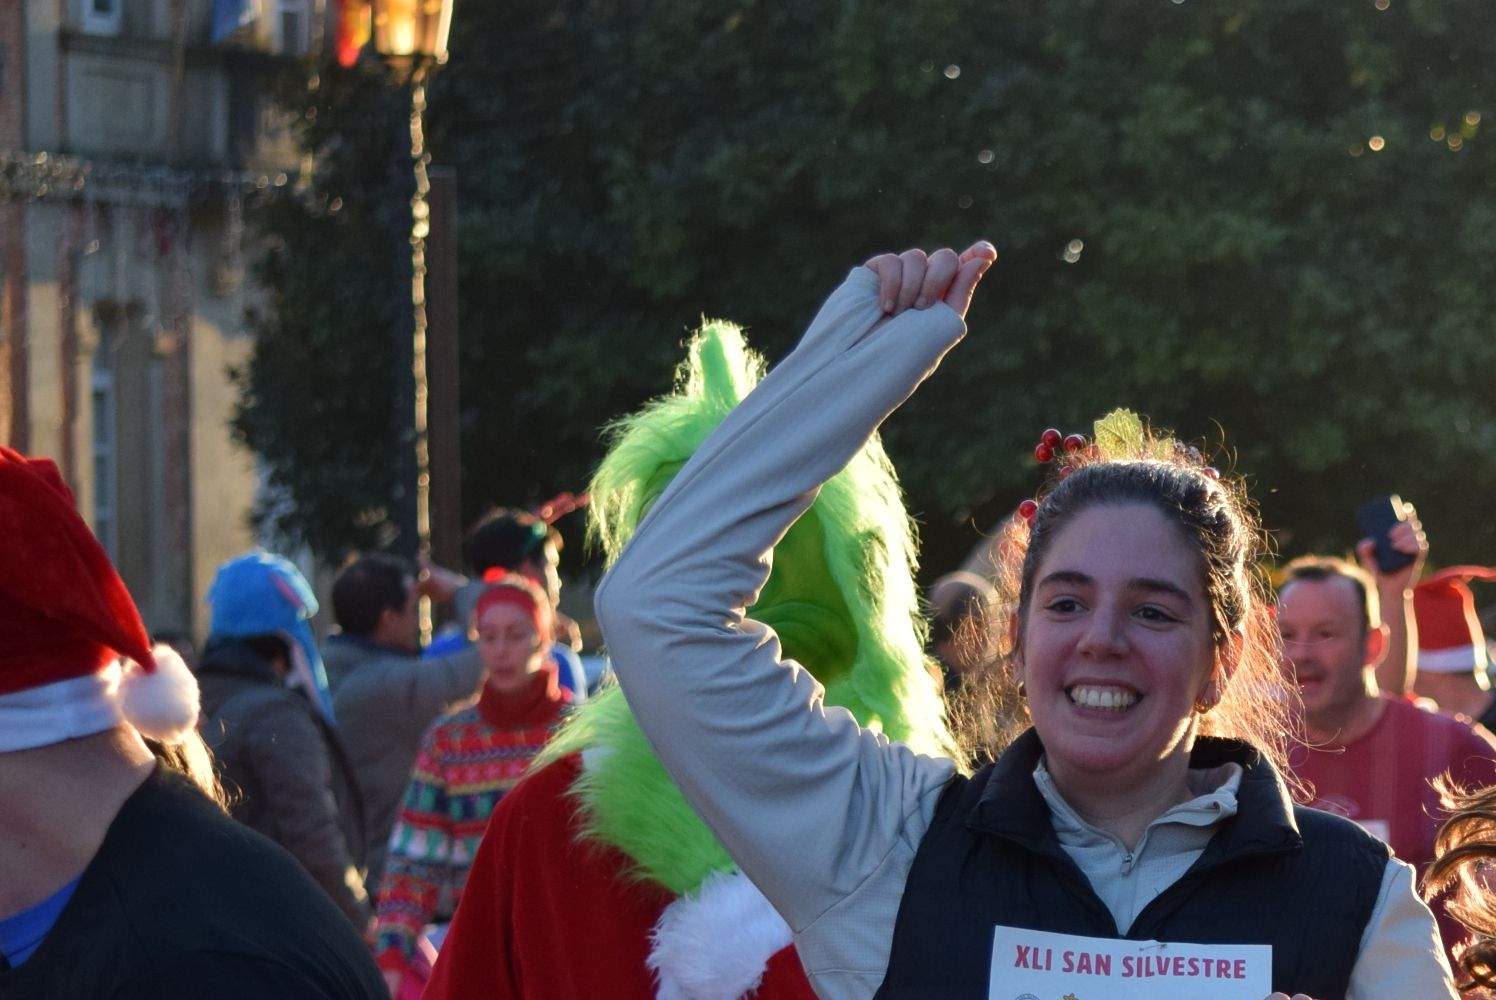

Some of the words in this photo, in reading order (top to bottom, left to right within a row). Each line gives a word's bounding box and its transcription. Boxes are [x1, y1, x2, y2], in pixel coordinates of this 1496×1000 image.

[1014, 944, 1052, 971] XLI
[1062, 951, 1112, 977] SAN
[1121, 955, 1247, 980] SILVESTRE
